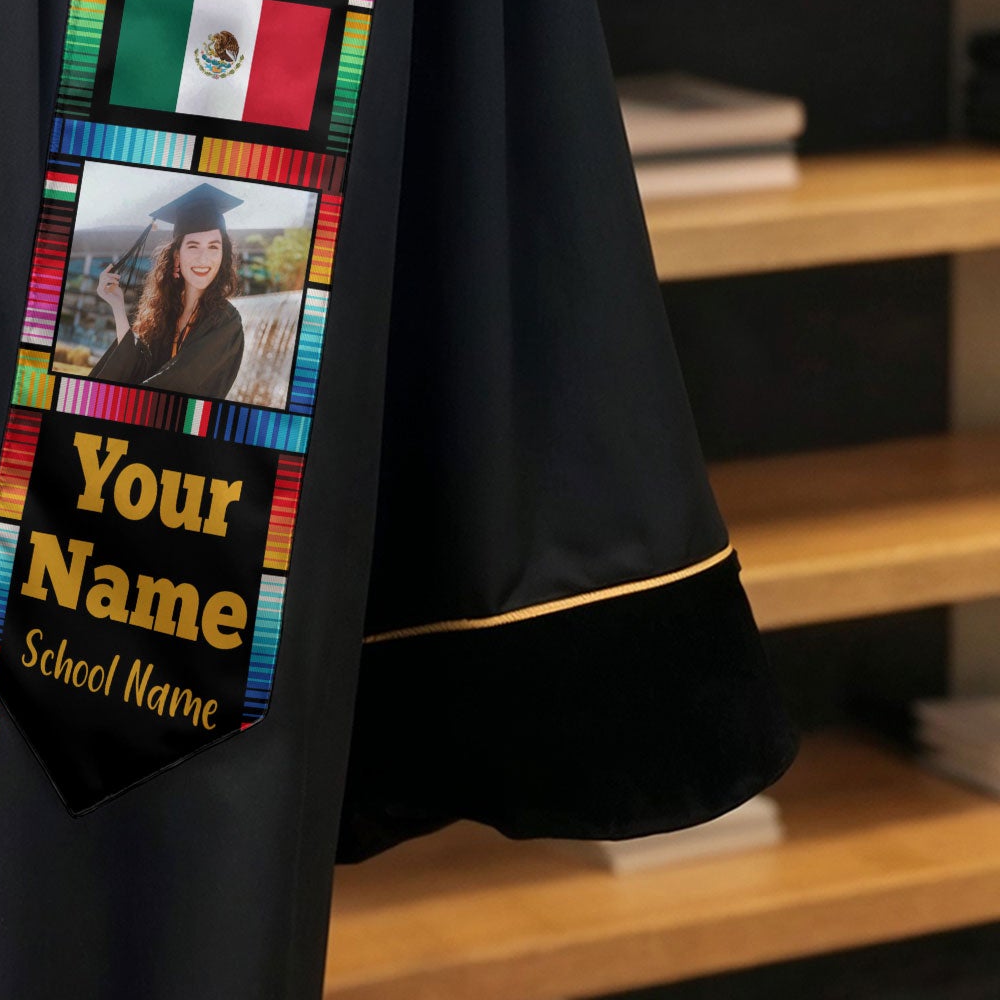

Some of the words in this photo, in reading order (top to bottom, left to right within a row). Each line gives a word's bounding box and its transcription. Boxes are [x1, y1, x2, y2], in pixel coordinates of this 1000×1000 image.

[73, 431, 243, 537] Your
[20, 530, 248, 650] Name
[21, 628, 120, 696] School
[123, 658, 218, 730] Name
